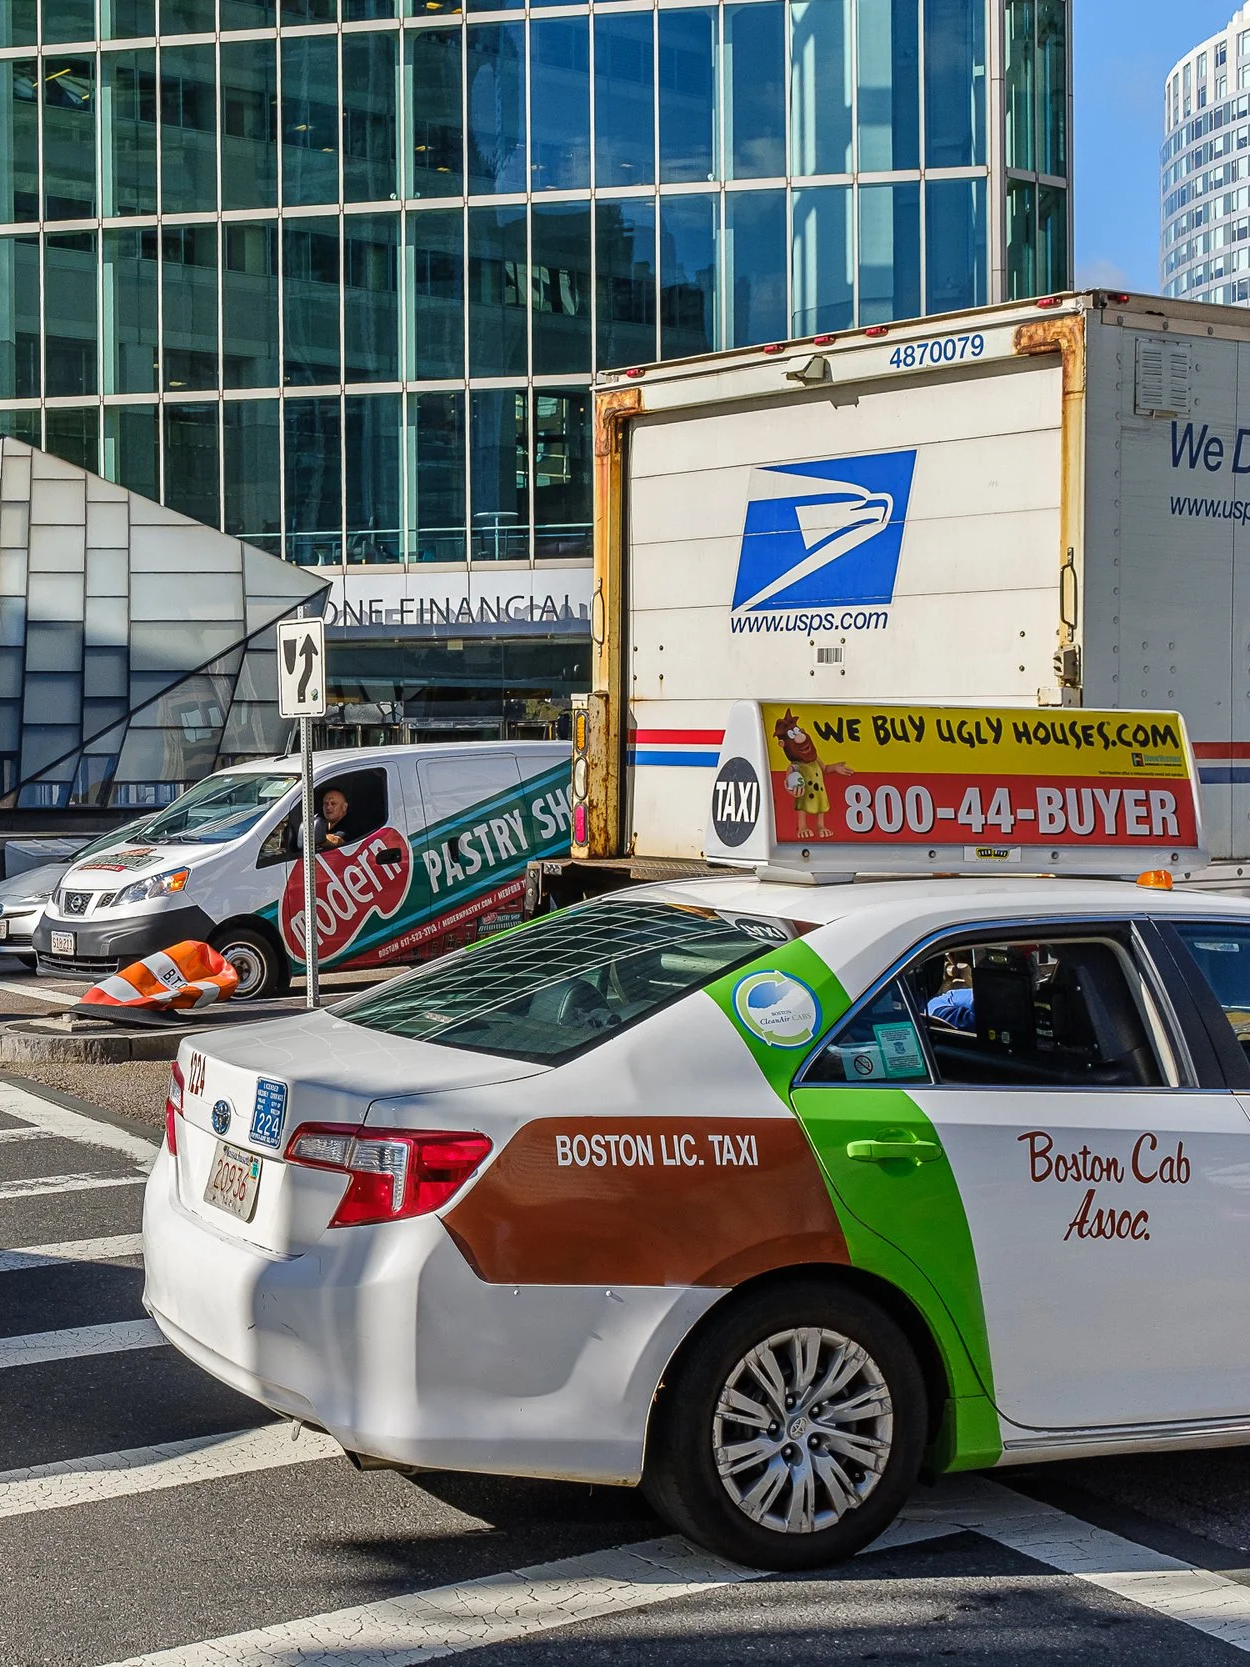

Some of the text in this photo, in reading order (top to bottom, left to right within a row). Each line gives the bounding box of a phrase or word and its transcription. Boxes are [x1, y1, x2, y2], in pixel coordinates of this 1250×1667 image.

[889, 333, 985, 369] 4870079
[1171, 420, 1224, 472] We
[400, 594, 580, 624] FINANCIAL
[731, 611, 889, 637] www.usps.com
[813, 717, 862, 744] WE
[871, 715, 925, 746] BUY
[935, 716, 1003, 749] UGLY
[715, 780, 758, 823] TAXI
[844, 784, 1180, 837] 800-44-BUYER
[421, 808, 530, 894] PASTRY
[791, 1012, 812, 1022] CABS
[188, 1050, 207, 1097] 1224
[253, 1110, 280, 1139] 1224
[555, 1133, 759, 1167] BOSTON LIC. TAXI
[1017, 1130, 1191, 1184] Boston Cab
[1063, 1188, 1150, 1242] Assoc.
